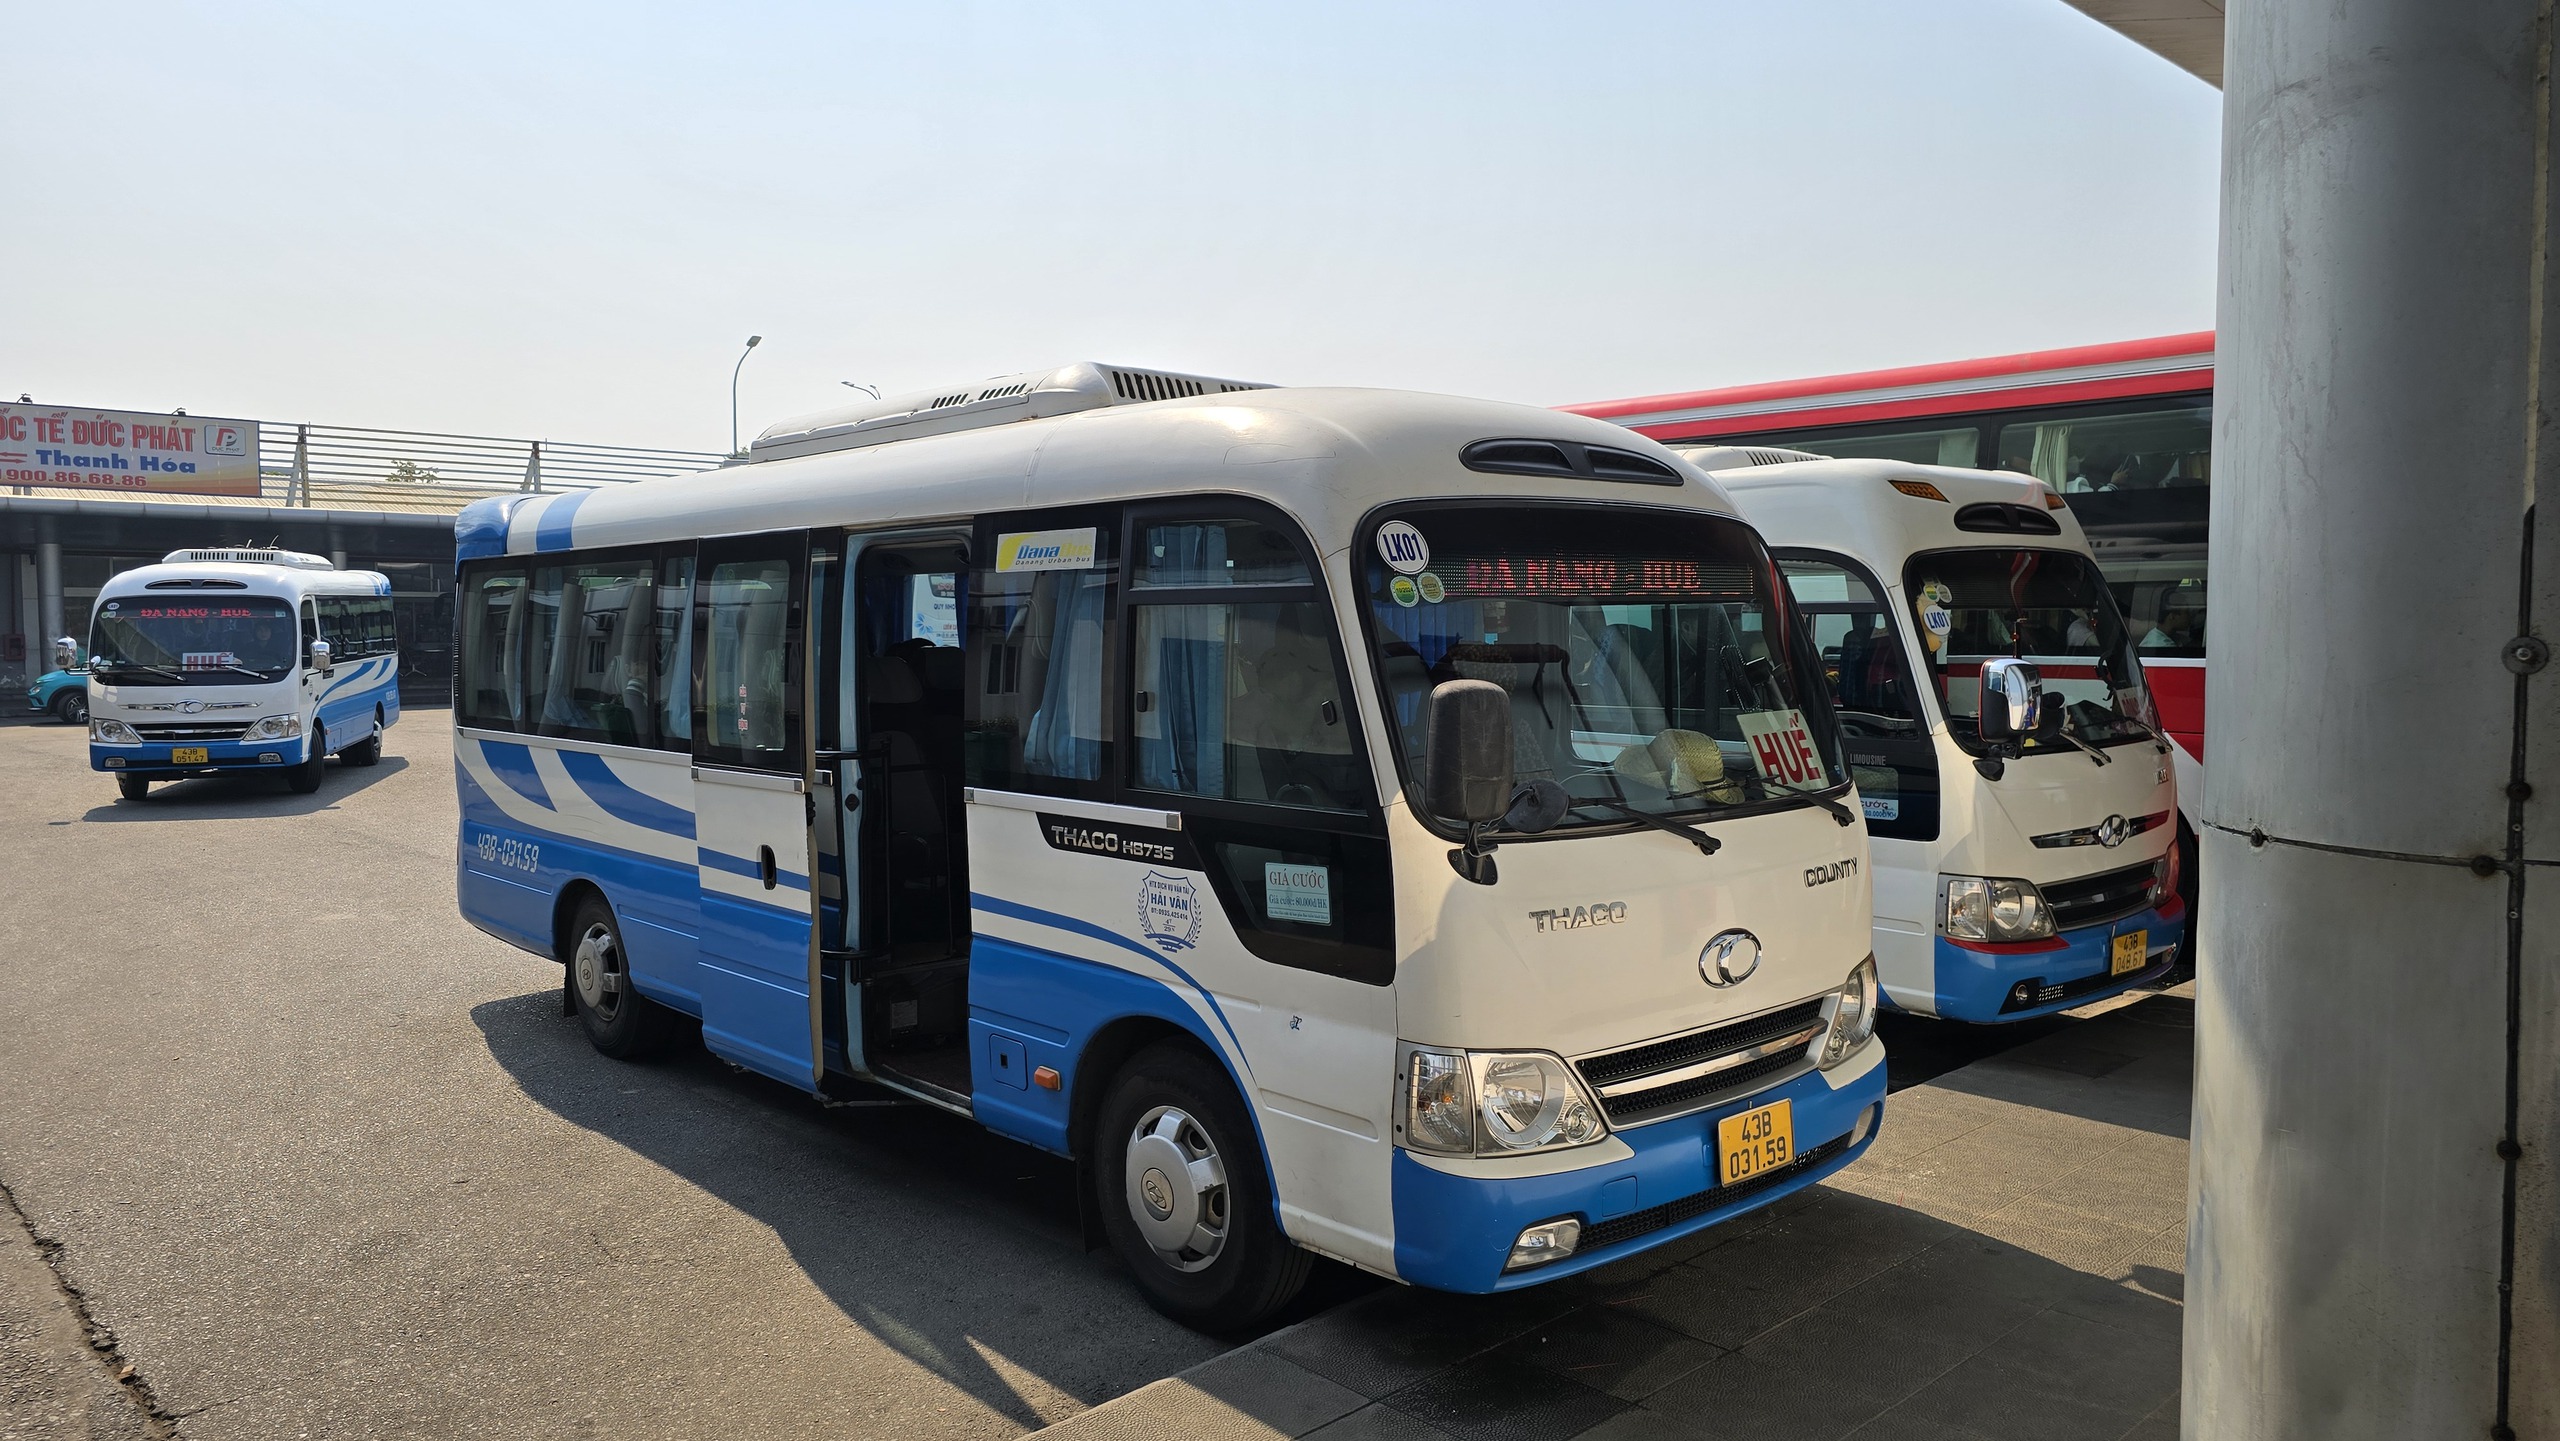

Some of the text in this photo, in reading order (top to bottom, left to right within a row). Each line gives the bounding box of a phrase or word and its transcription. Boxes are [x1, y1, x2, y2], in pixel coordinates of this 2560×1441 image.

[33, 410, 68, 443] TẾ
[72, 414, 125, 447] ĐỨC
[132, 420, 196, 452] PHÁT
[36, 450, 196, 474] Thanh Hóa
[0, 468, 147, 487] 900.86.68.86
[1382, 532, 1424, 562] LK01
[1926, 611, 1950, 629] LK01
[182, 748, 198, 756] 43B
[1752, 712, 1822, 785] HUẾ
[1849, 753, 1887, 766] LIMOUSINE
[1051, 825, 1175, 861] THACO HB73S
[1269, 868, 1325, 889] GIÁ CƯỚC
[1803, 857, 1859, 888] COUNTY
[1151, 891, 1188, 911] HẢI VÂN
[1528, 901, 1628, 933] THACO
[2123, 933, 2139, 951] 43B
[1742, 1110, 1772, 1143] 43B
[1730, 1136, 1787, 1179] 031.59
